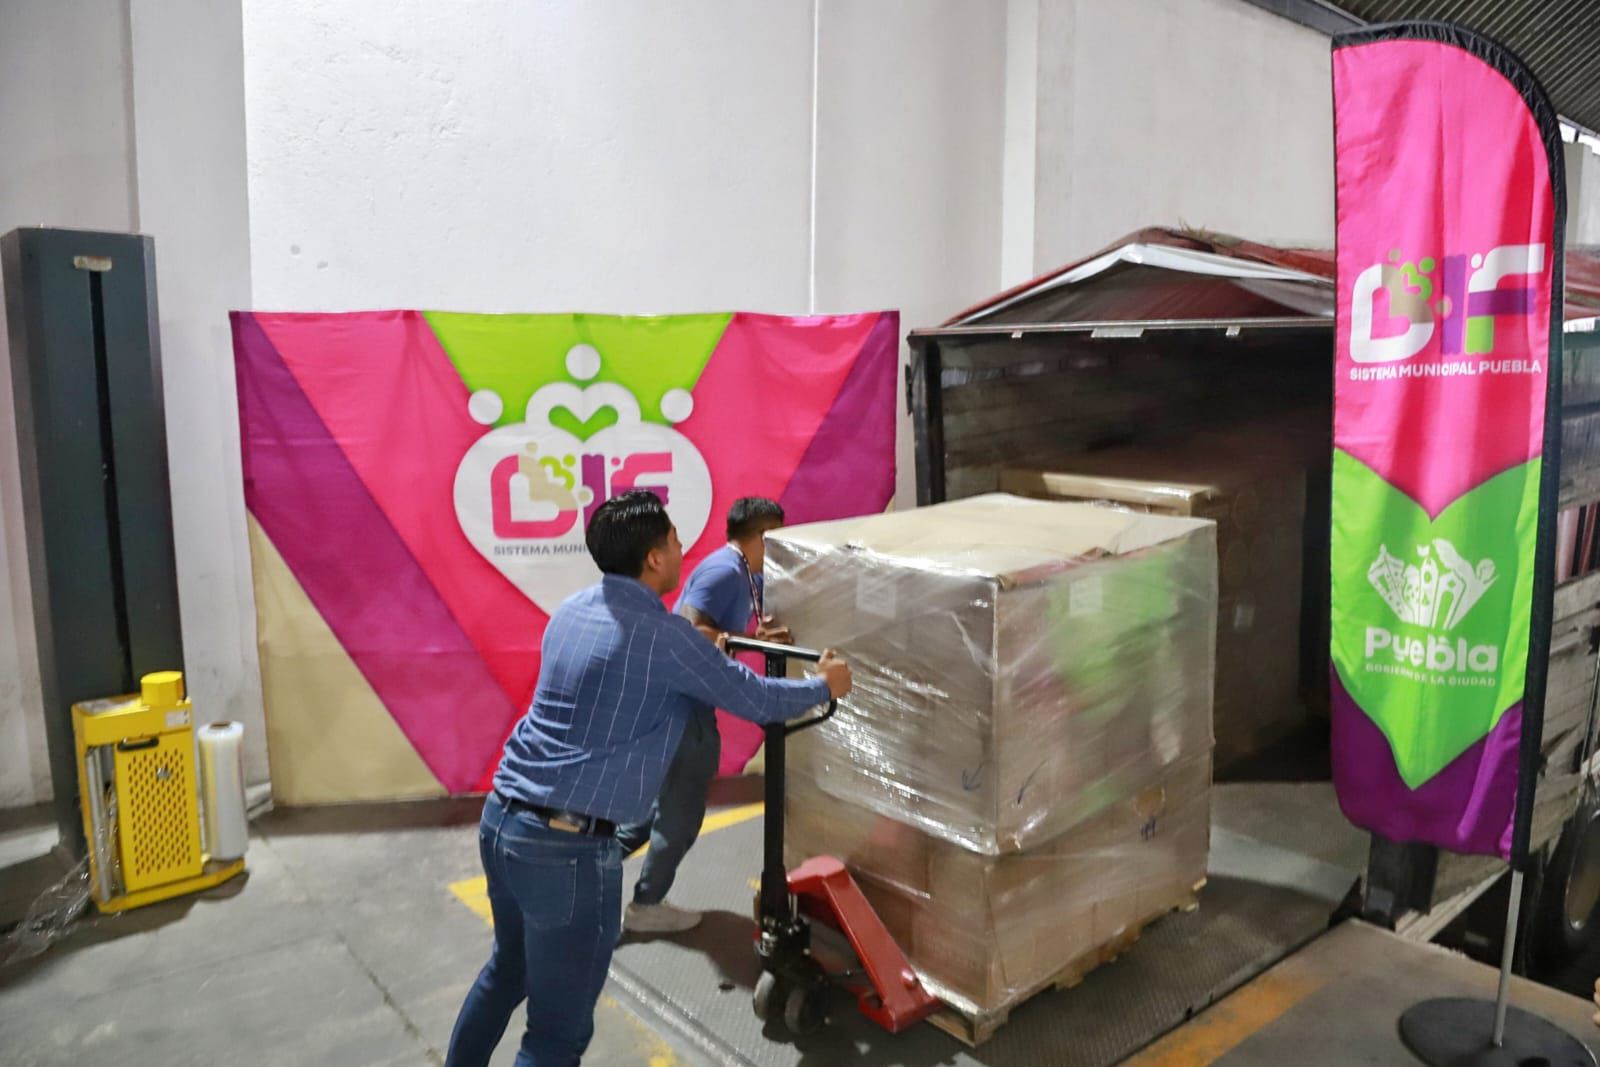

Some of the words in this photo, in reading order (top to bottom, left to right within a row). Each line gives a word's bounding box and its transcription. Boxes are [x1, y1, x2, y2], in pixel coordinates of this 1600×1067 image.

[1350, 243, 1546, 364] DIF
[1349, 365, 1397, 381] SISTEMA
[1399, 362, 1476, 377] MUNICIPAL
[1479, 359, 1542, 374] PUEBLA
[494, 543, 550, 556] SISTEMA
[553, 543, 587, 555] MUNI
[1365, 626, 1499, 673] Puebla
[1430, 675, 1445, 686] LA
[1449, 676, 1496, 687] CIUDAD
